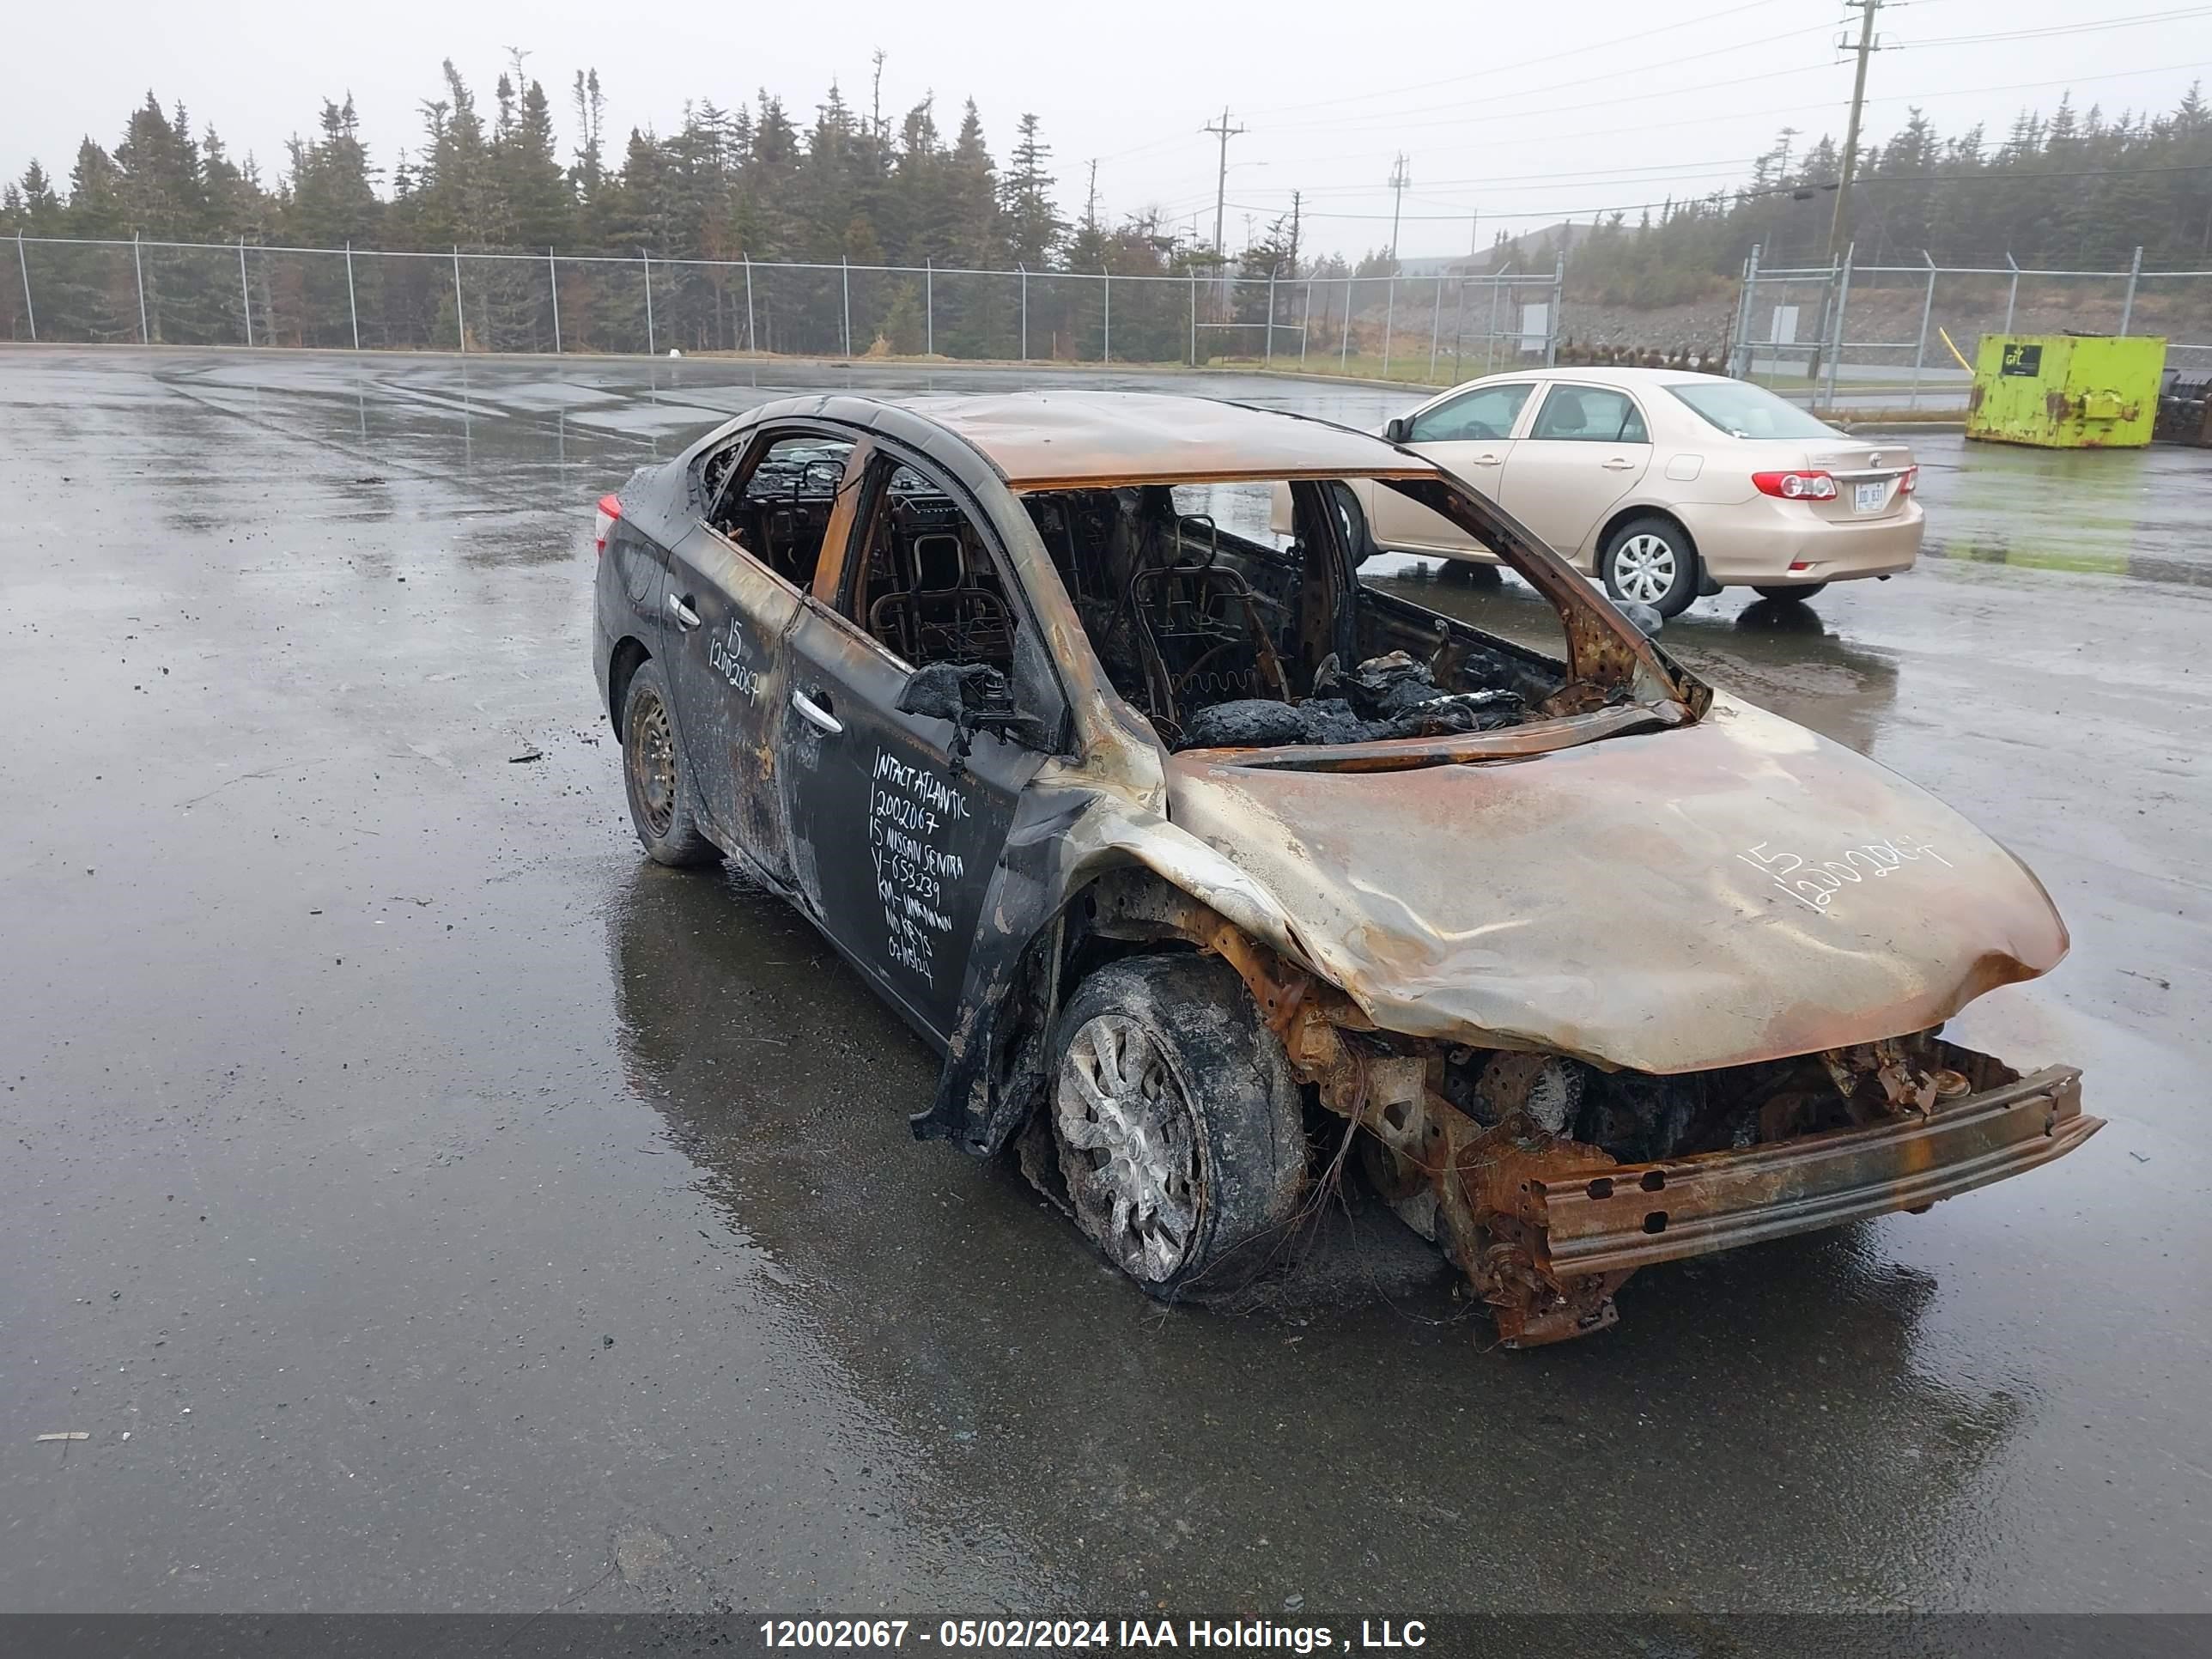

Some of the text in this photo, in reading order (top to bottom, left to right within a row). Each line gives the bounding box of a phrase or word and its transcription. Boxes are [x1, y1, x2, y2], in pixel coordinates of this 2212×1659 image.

[727, 617, 743, 659] 15
[708, 637, 761, 708] 12002067
[869, 781, 940, 836] 12002067
[872, 745, 971, 821] INTACT ATLANTIC
[869, 815, 963, 880] 15 NISSAN SENTRA
[1736, 841, 1802, 884] 15
[1773, 835, 1954, 915] 12002067
[884, 904, 933, 958] NO KEYS
